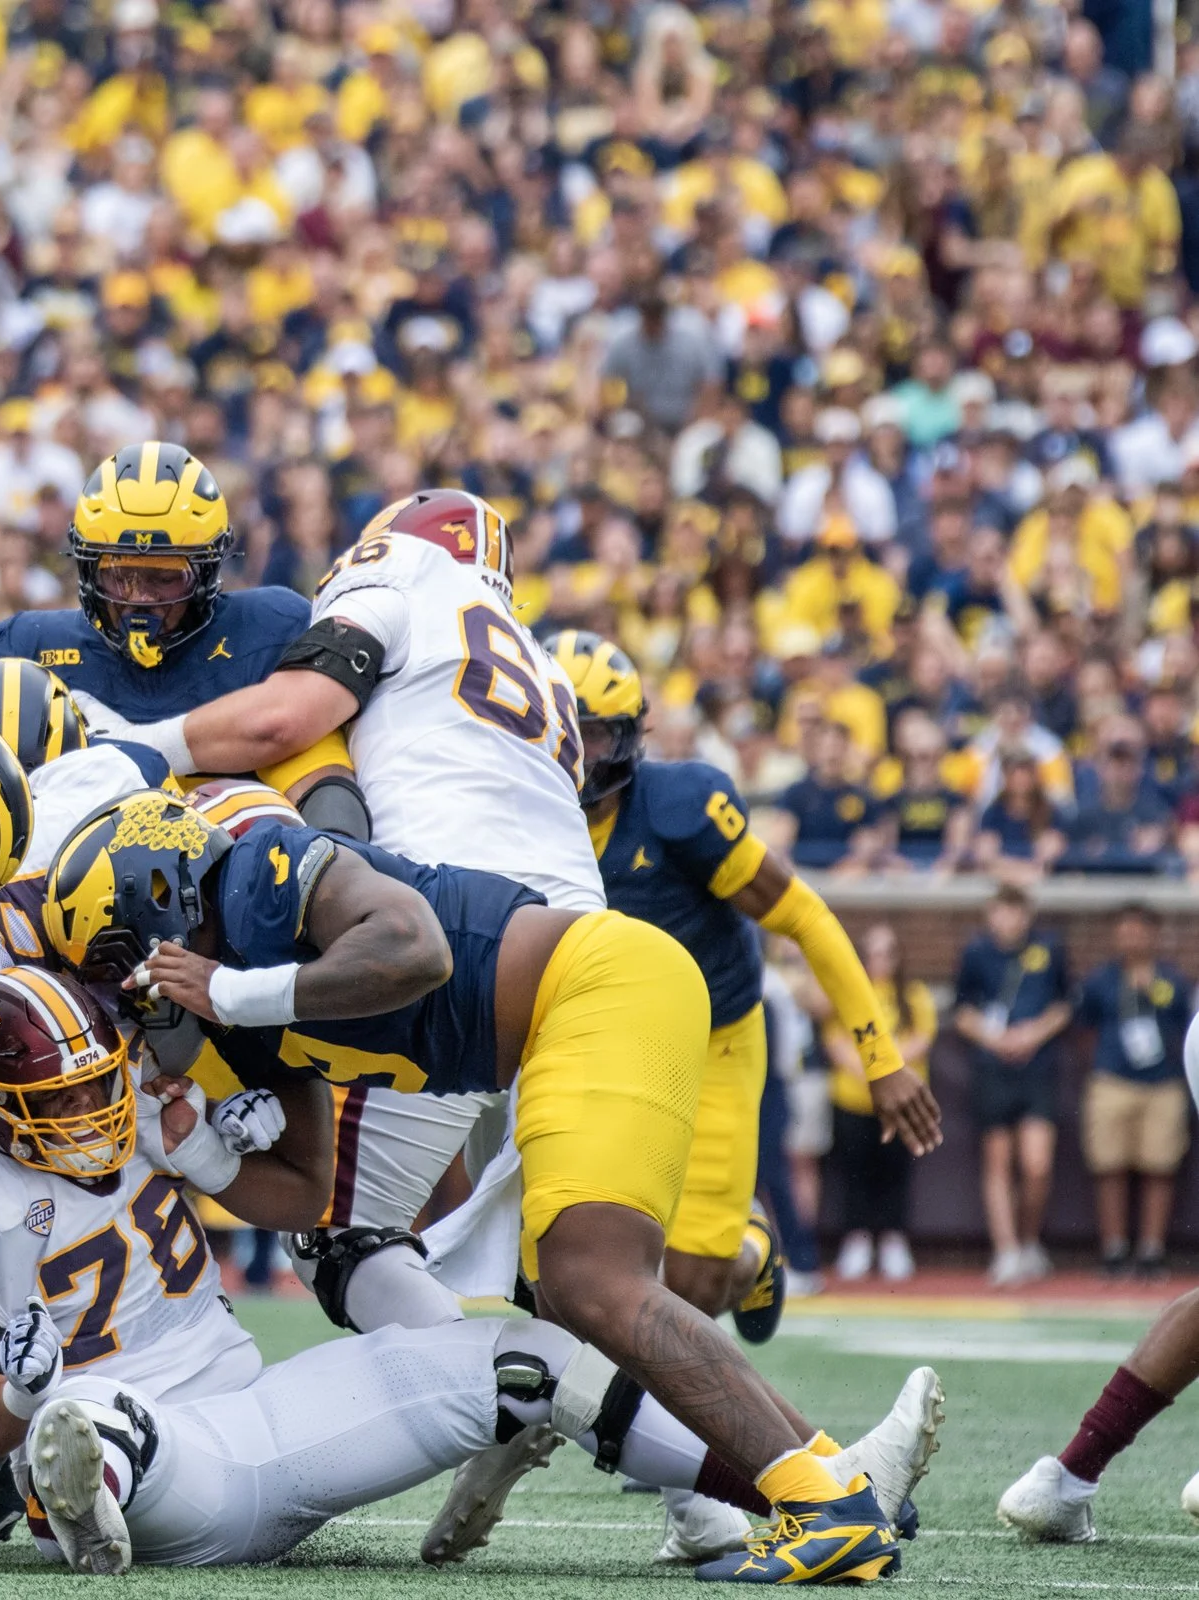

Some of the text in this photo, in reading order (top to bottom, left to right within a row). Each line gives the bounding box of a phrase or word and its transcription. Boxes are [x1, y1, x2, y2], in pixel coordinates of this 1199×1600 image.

[135, 533, 152, 545] M
[706, 791, 746, 841] 6
[73, 1049, 101, 1069] 1974
